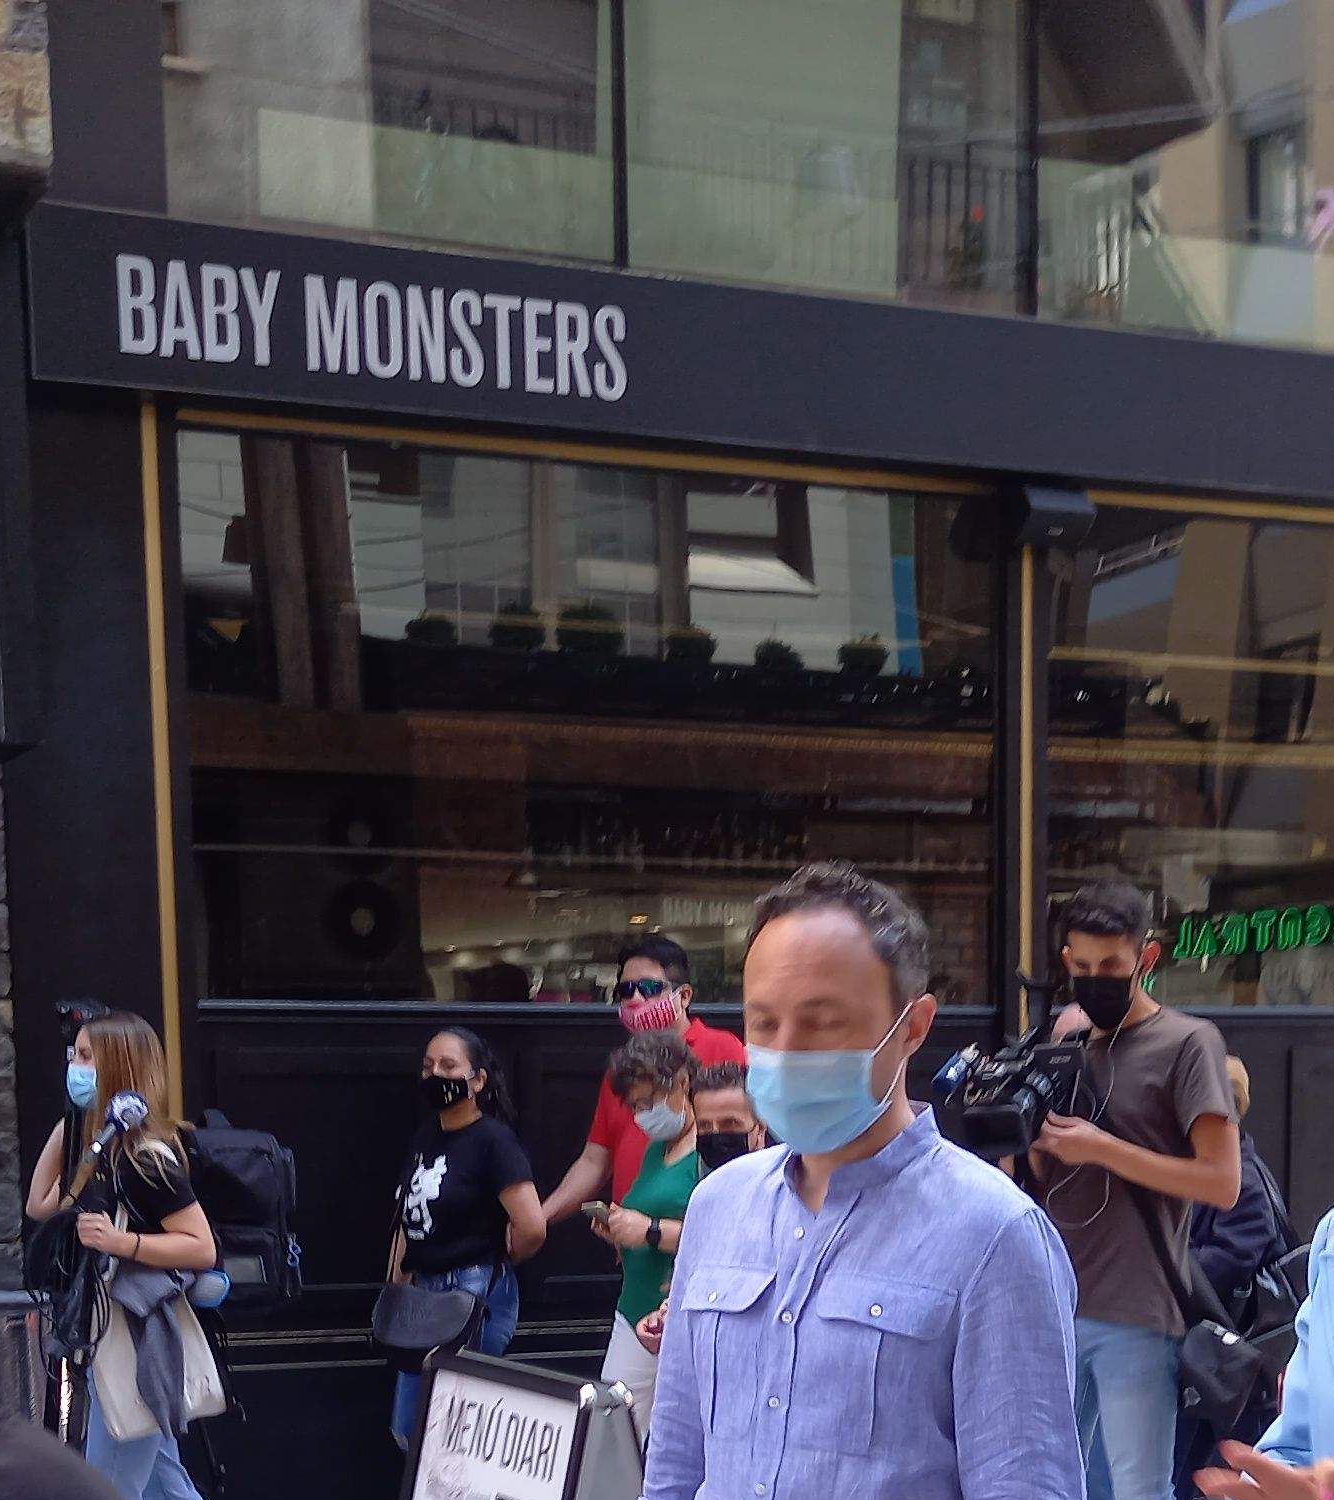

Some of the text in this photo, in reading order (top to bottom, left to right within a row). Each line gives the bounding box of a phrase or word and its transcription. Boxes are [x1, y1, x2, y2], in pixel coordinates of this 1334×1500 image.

[115, 252, 629, 403] BABY MONSTERS
[441, 1395, 563, 1483] MENÚ DIARI
